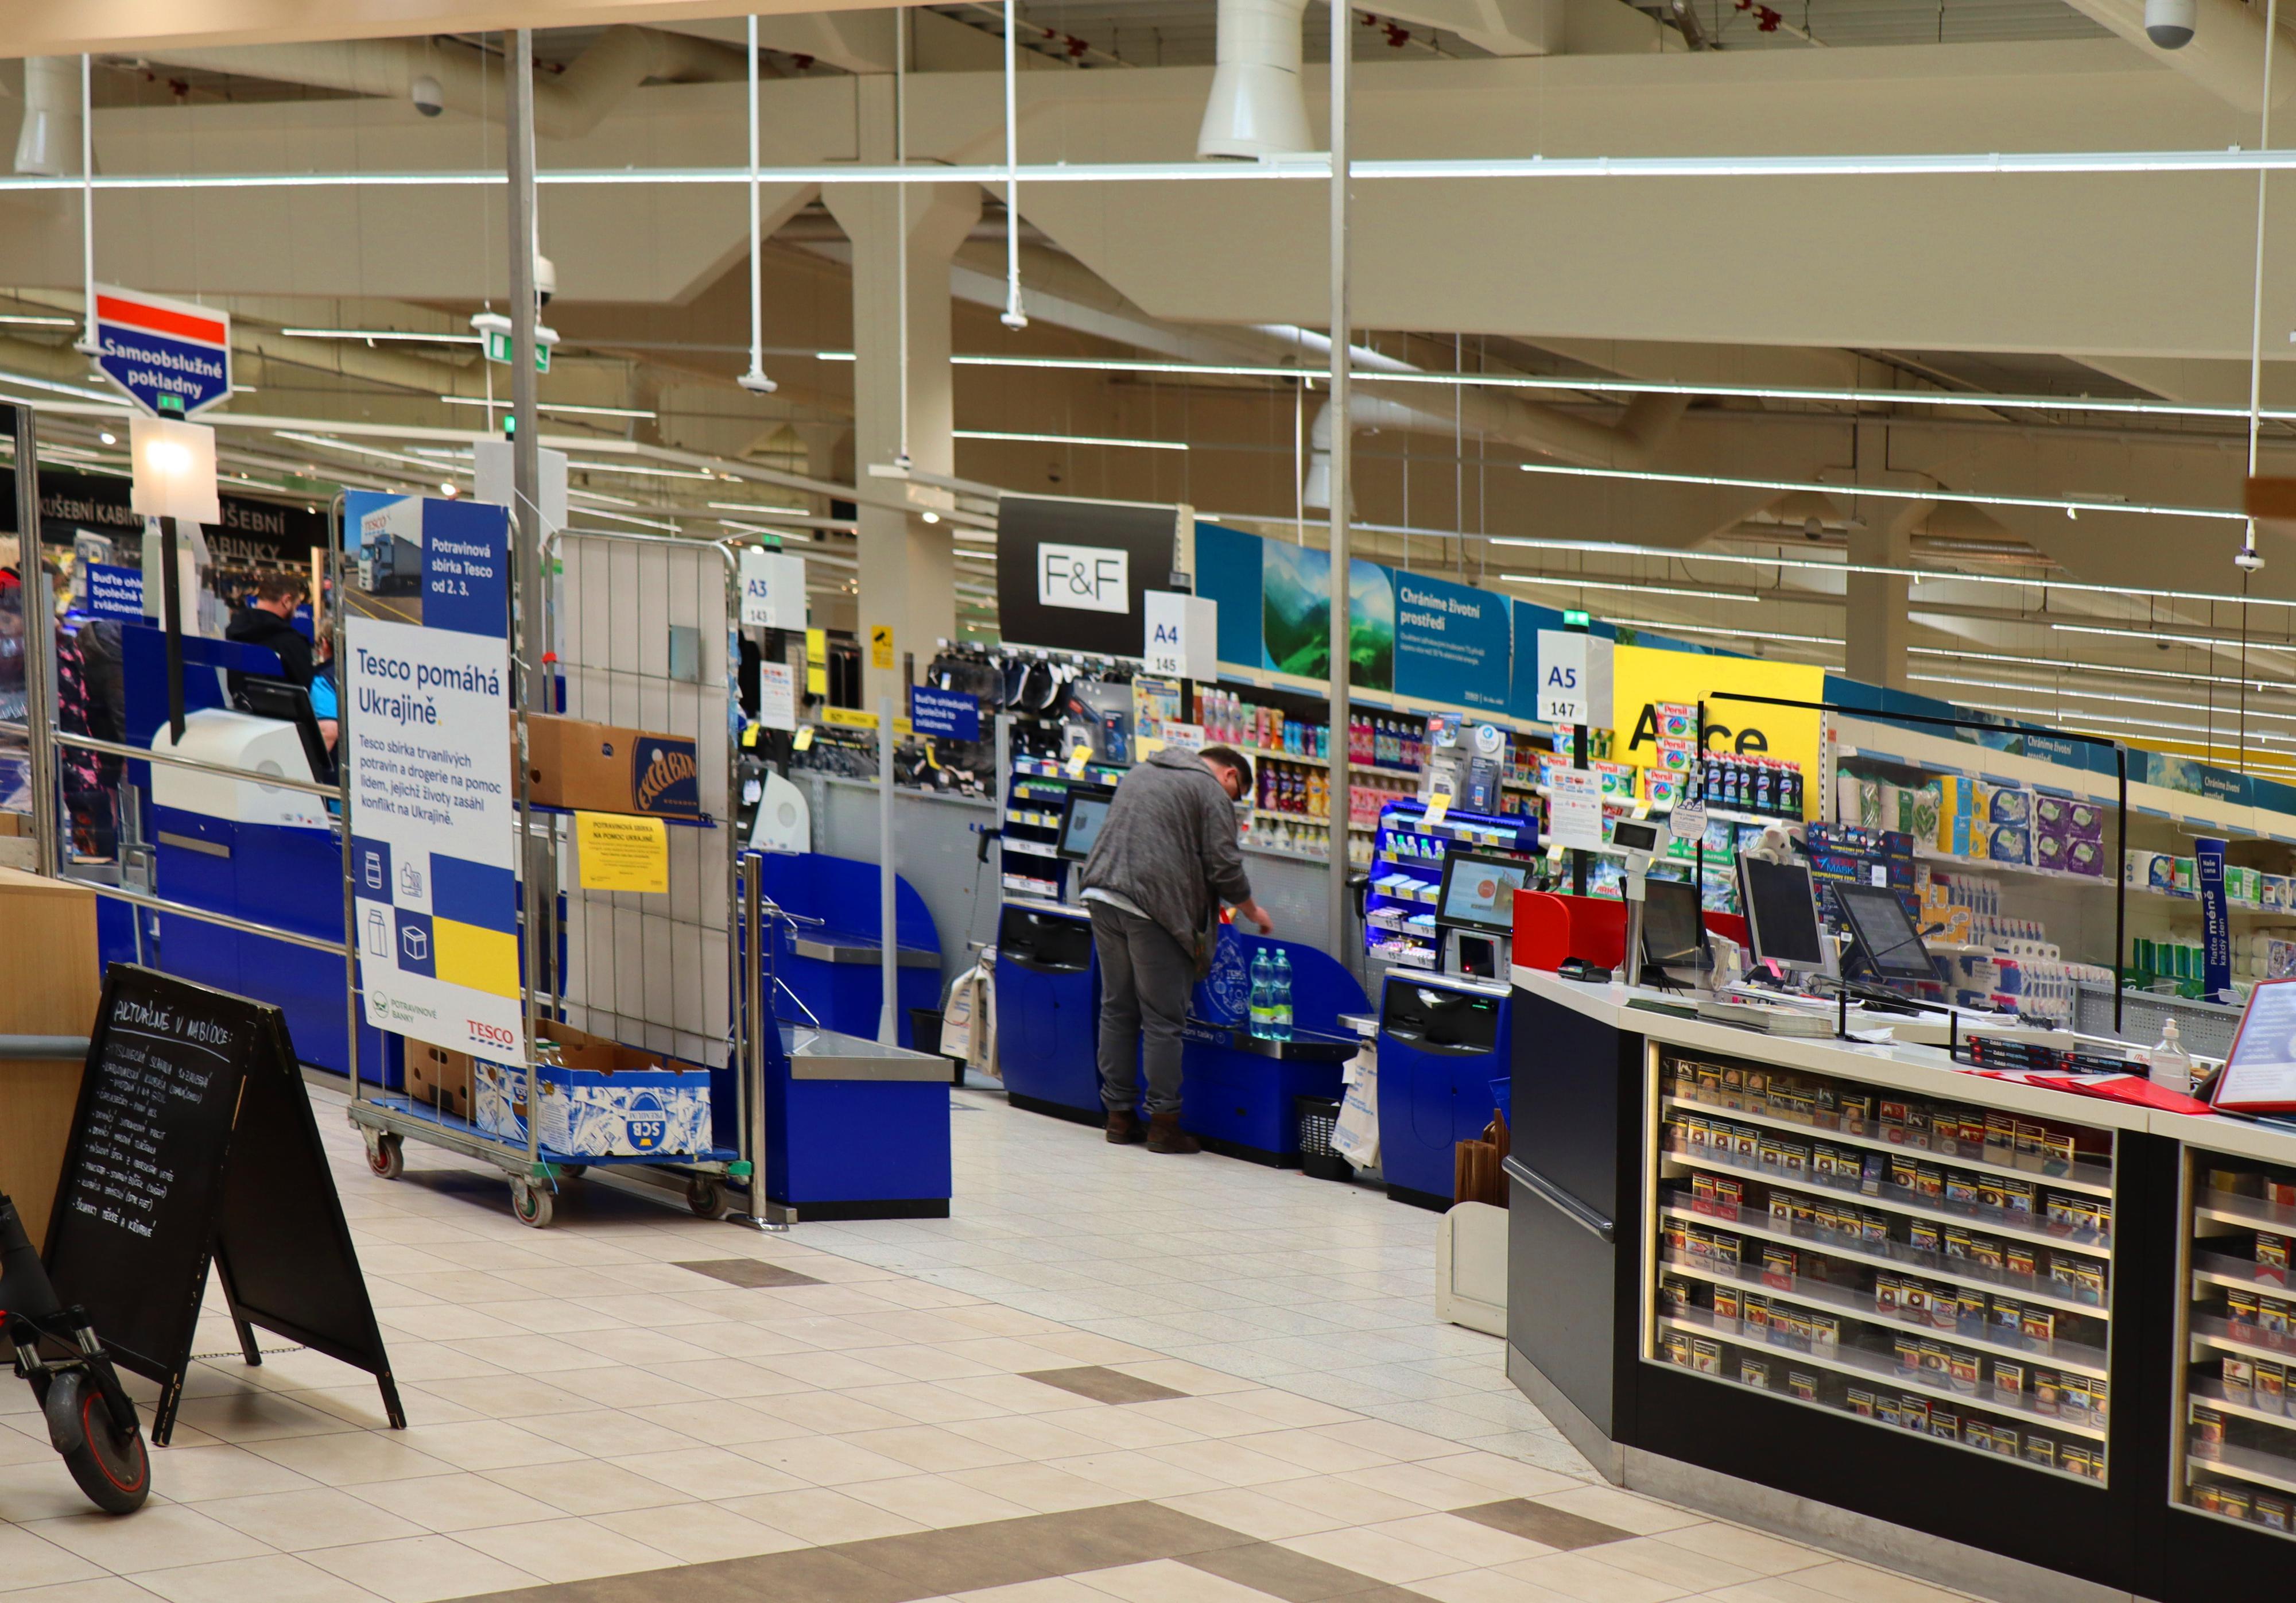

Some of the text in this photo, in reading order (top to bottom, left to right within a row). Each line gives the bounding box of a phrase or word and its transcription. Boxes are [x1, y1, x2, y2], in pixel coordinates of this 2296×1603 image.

[104, 338, 223, 379] Samoobslužné
[127, 369, 203, 400] pokladny
[96, 501, 144, 526] KABIN
[432, 537, 491, 558] Potravinová
[432, 557, 493, 578] sbírka Tesco
[1045, 554, 1120, 601] F&F
[432, 580, 470, 596] od 2. 3.
[748, 579, 767, 598] A3
[750, 610, 768, 623] 143
[1400, 610, 1445, 631] prostředí
[1153, 623, 1178, 645] A4
[356, 648, 500, 696] Tesco pomáhá
[1155, 657, 1177, 673] 145
[1547, 665, 1577, 690] A5
[359, 687, 443, 726] Ukrajině.
[1551, 702, 1576, 718] 147
[1664, 705, 1688, 716] Persil
[359, 734, 472, 768] Tesco sbírka trvanlivých
[1663, 739, 1686, 750] Persil
[1547, 756, 1568, 766] Persil
[1595, 762, 1618, 773] Persil
[360, 756, 502, 794] potravin a drogerie na pomoc
[1650, 770, 1673, 781] Persil
[360, 774, 484, 811] lidem, jejichž životy zasáhl
[361, 795, 454, 826] konflikt na Ukrajině.
[1596, 886, 1619, 896] ARIEL
[2204, 890, 2217, 935] méně
[2219, 939, 2227, 966] každý
[390, 998, 437, 1020] POTRAVINOVÉ
[392, 1010, 414, 1024] BANKY
[175, 1015, 184, 1033] V
[466, 1020, 514, 1044] TESCO
[633, 1121, 661, 1137] SCB
